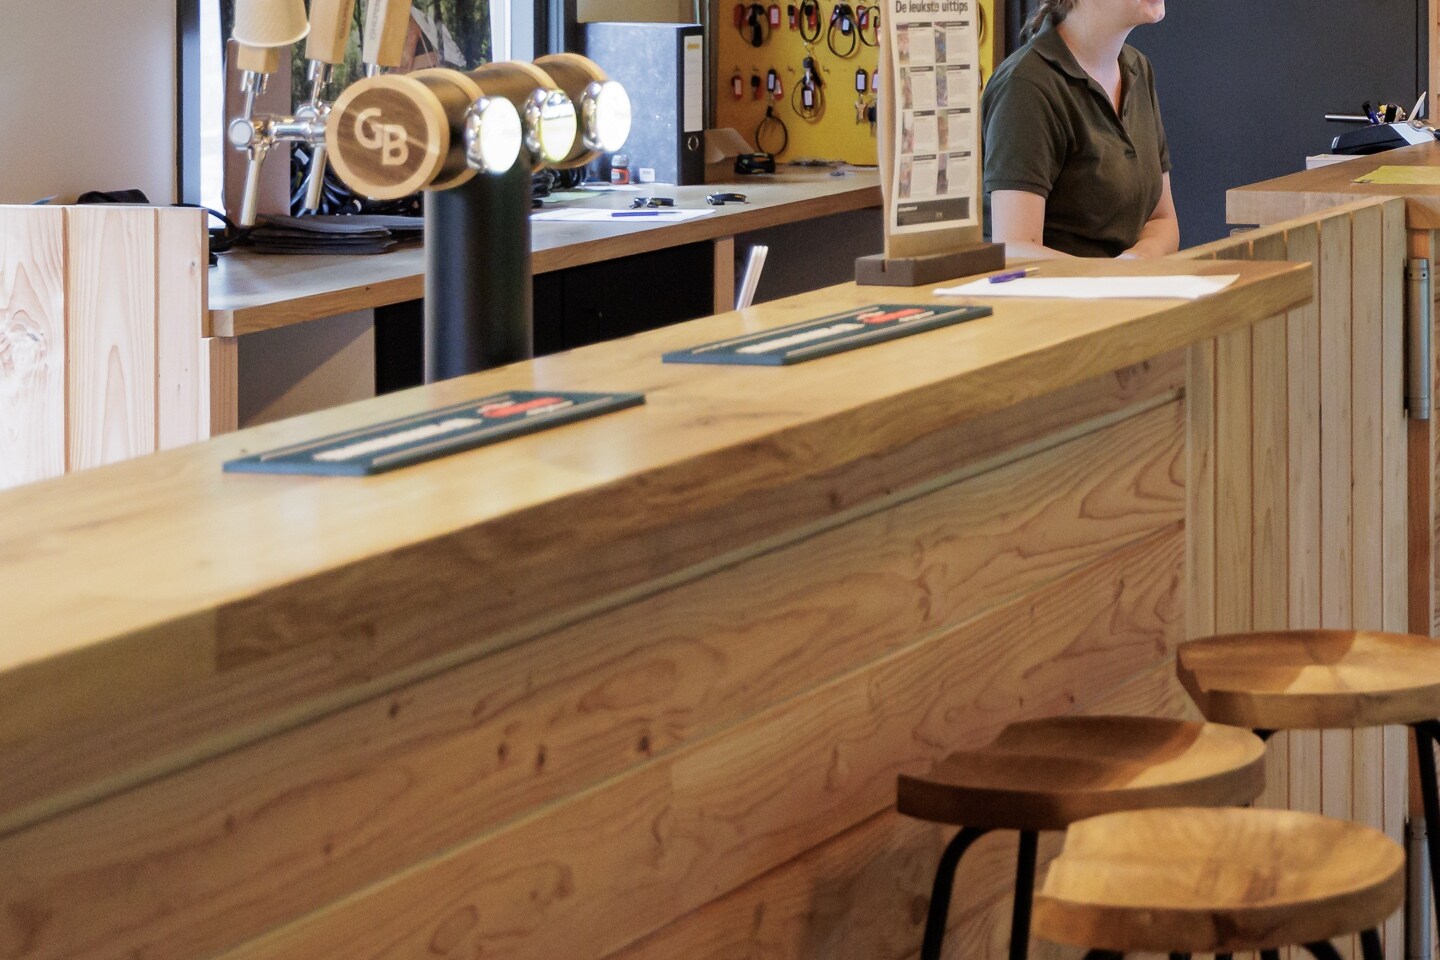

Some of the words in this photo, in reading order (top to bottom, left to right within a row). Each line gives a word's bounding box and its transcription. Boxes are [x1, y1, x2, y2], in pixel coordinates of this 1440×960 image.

[895, 0, 907, 14] De
[909, 0, 939, 13] leukste
[354, 107, 409, 166] GB
